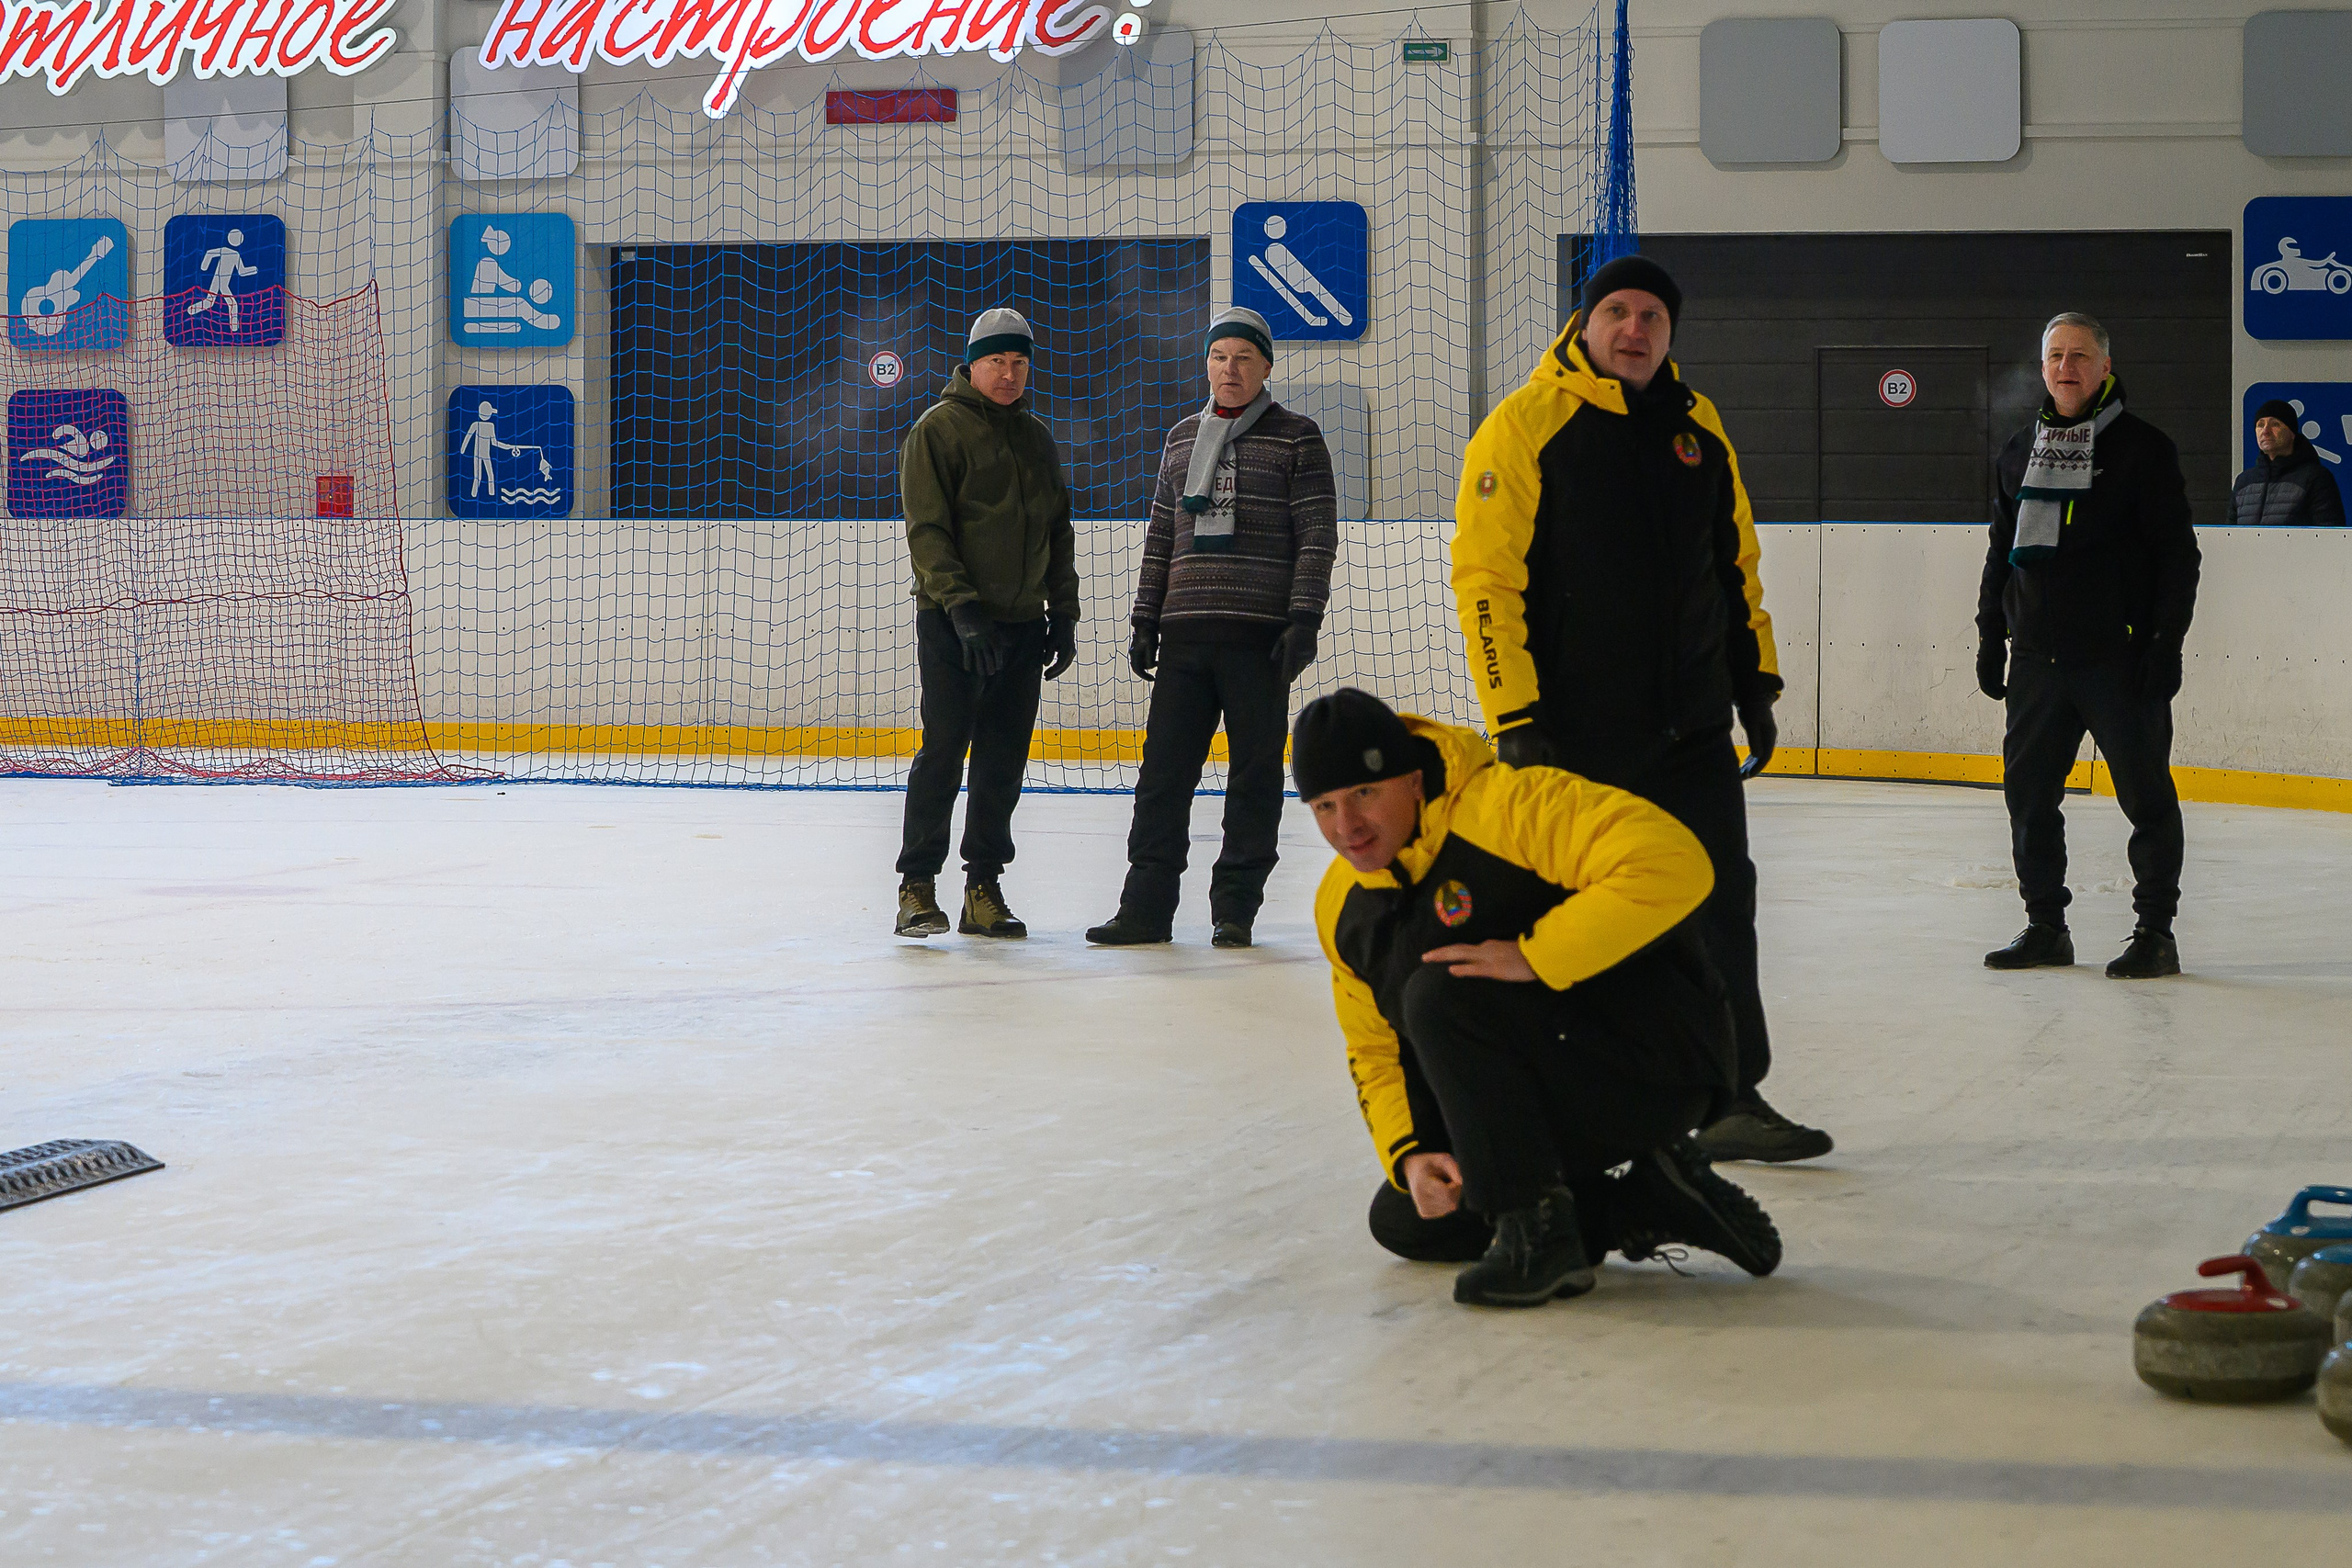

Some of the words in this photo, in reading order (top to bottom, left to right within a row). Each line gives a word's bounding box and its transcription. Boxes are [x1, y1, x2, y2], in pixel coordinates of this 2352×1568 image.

[0, 0, 390, 88] тличное
[485, 0, 1133, 110] настроение
[2040, 428, 2091, 444] ДИНЫЕ
[1476, 599, 1503, 690] BELARUS
